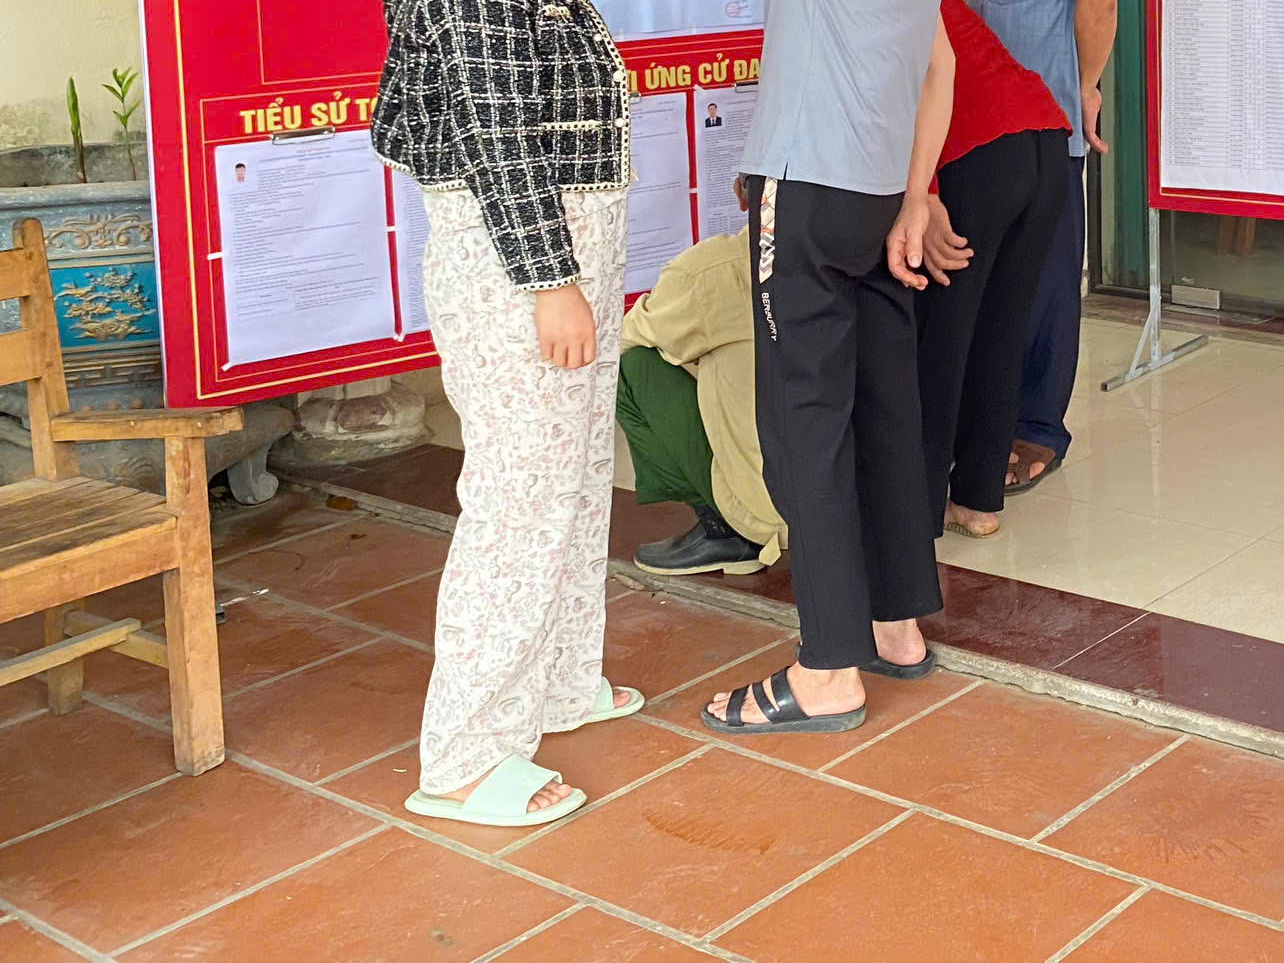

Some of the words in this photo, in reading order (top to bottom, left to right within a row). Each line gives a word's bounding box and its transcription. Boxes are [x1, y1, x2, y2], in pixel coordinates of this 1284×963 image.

[240, 97, 301, 134] TIỂU
[312, 91, 350, 126] SỬ
[645, 59, 692, 90] ỨNG
[698, 53, 730, 86] CỬ
